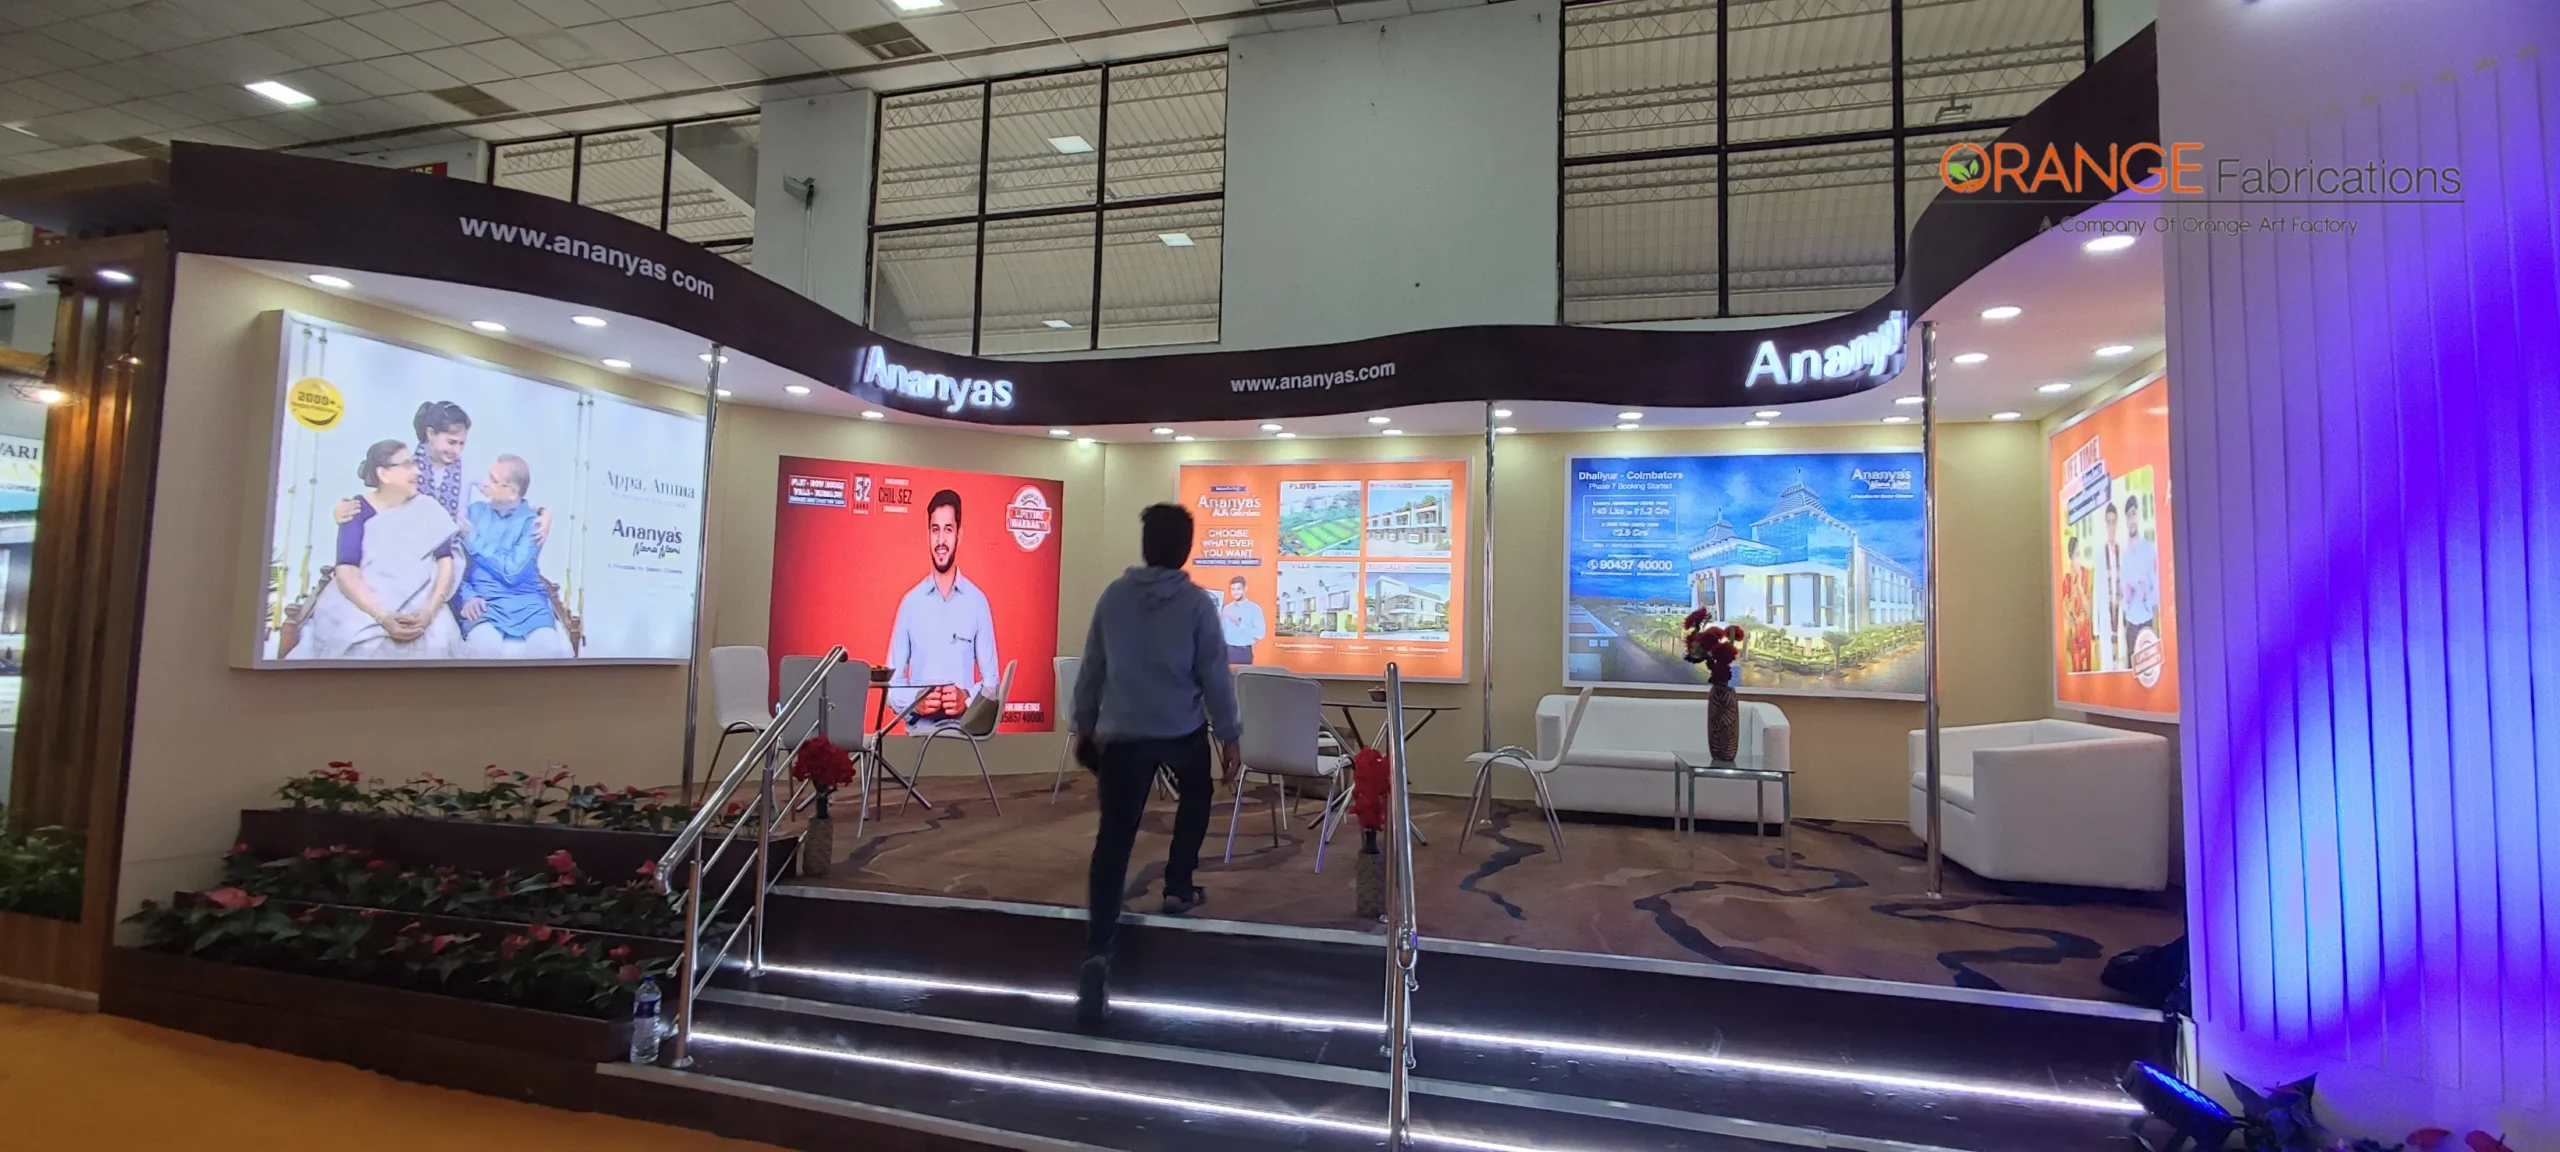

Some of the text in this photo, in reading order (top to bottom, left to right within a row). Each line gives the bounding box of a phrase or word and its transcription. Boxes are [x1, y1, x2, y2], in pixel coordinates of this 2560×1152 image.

[861, 344, 1014, 413] Ananyas
[1230, 361, 1396, 392] www.ananyas.com
[853, 476, 872, 502] 52
[1198, 494, 1261, 510] Ananya's
[612, 518, 683, 546] Ananya's
[1208, 529, 1249, 538] CHOOSE
[1203, 539, 1254, 547] WHATEVER
[1203, 549, 1253, 557] YOU WANT
[1637, 560, 1673, 570] 40000
